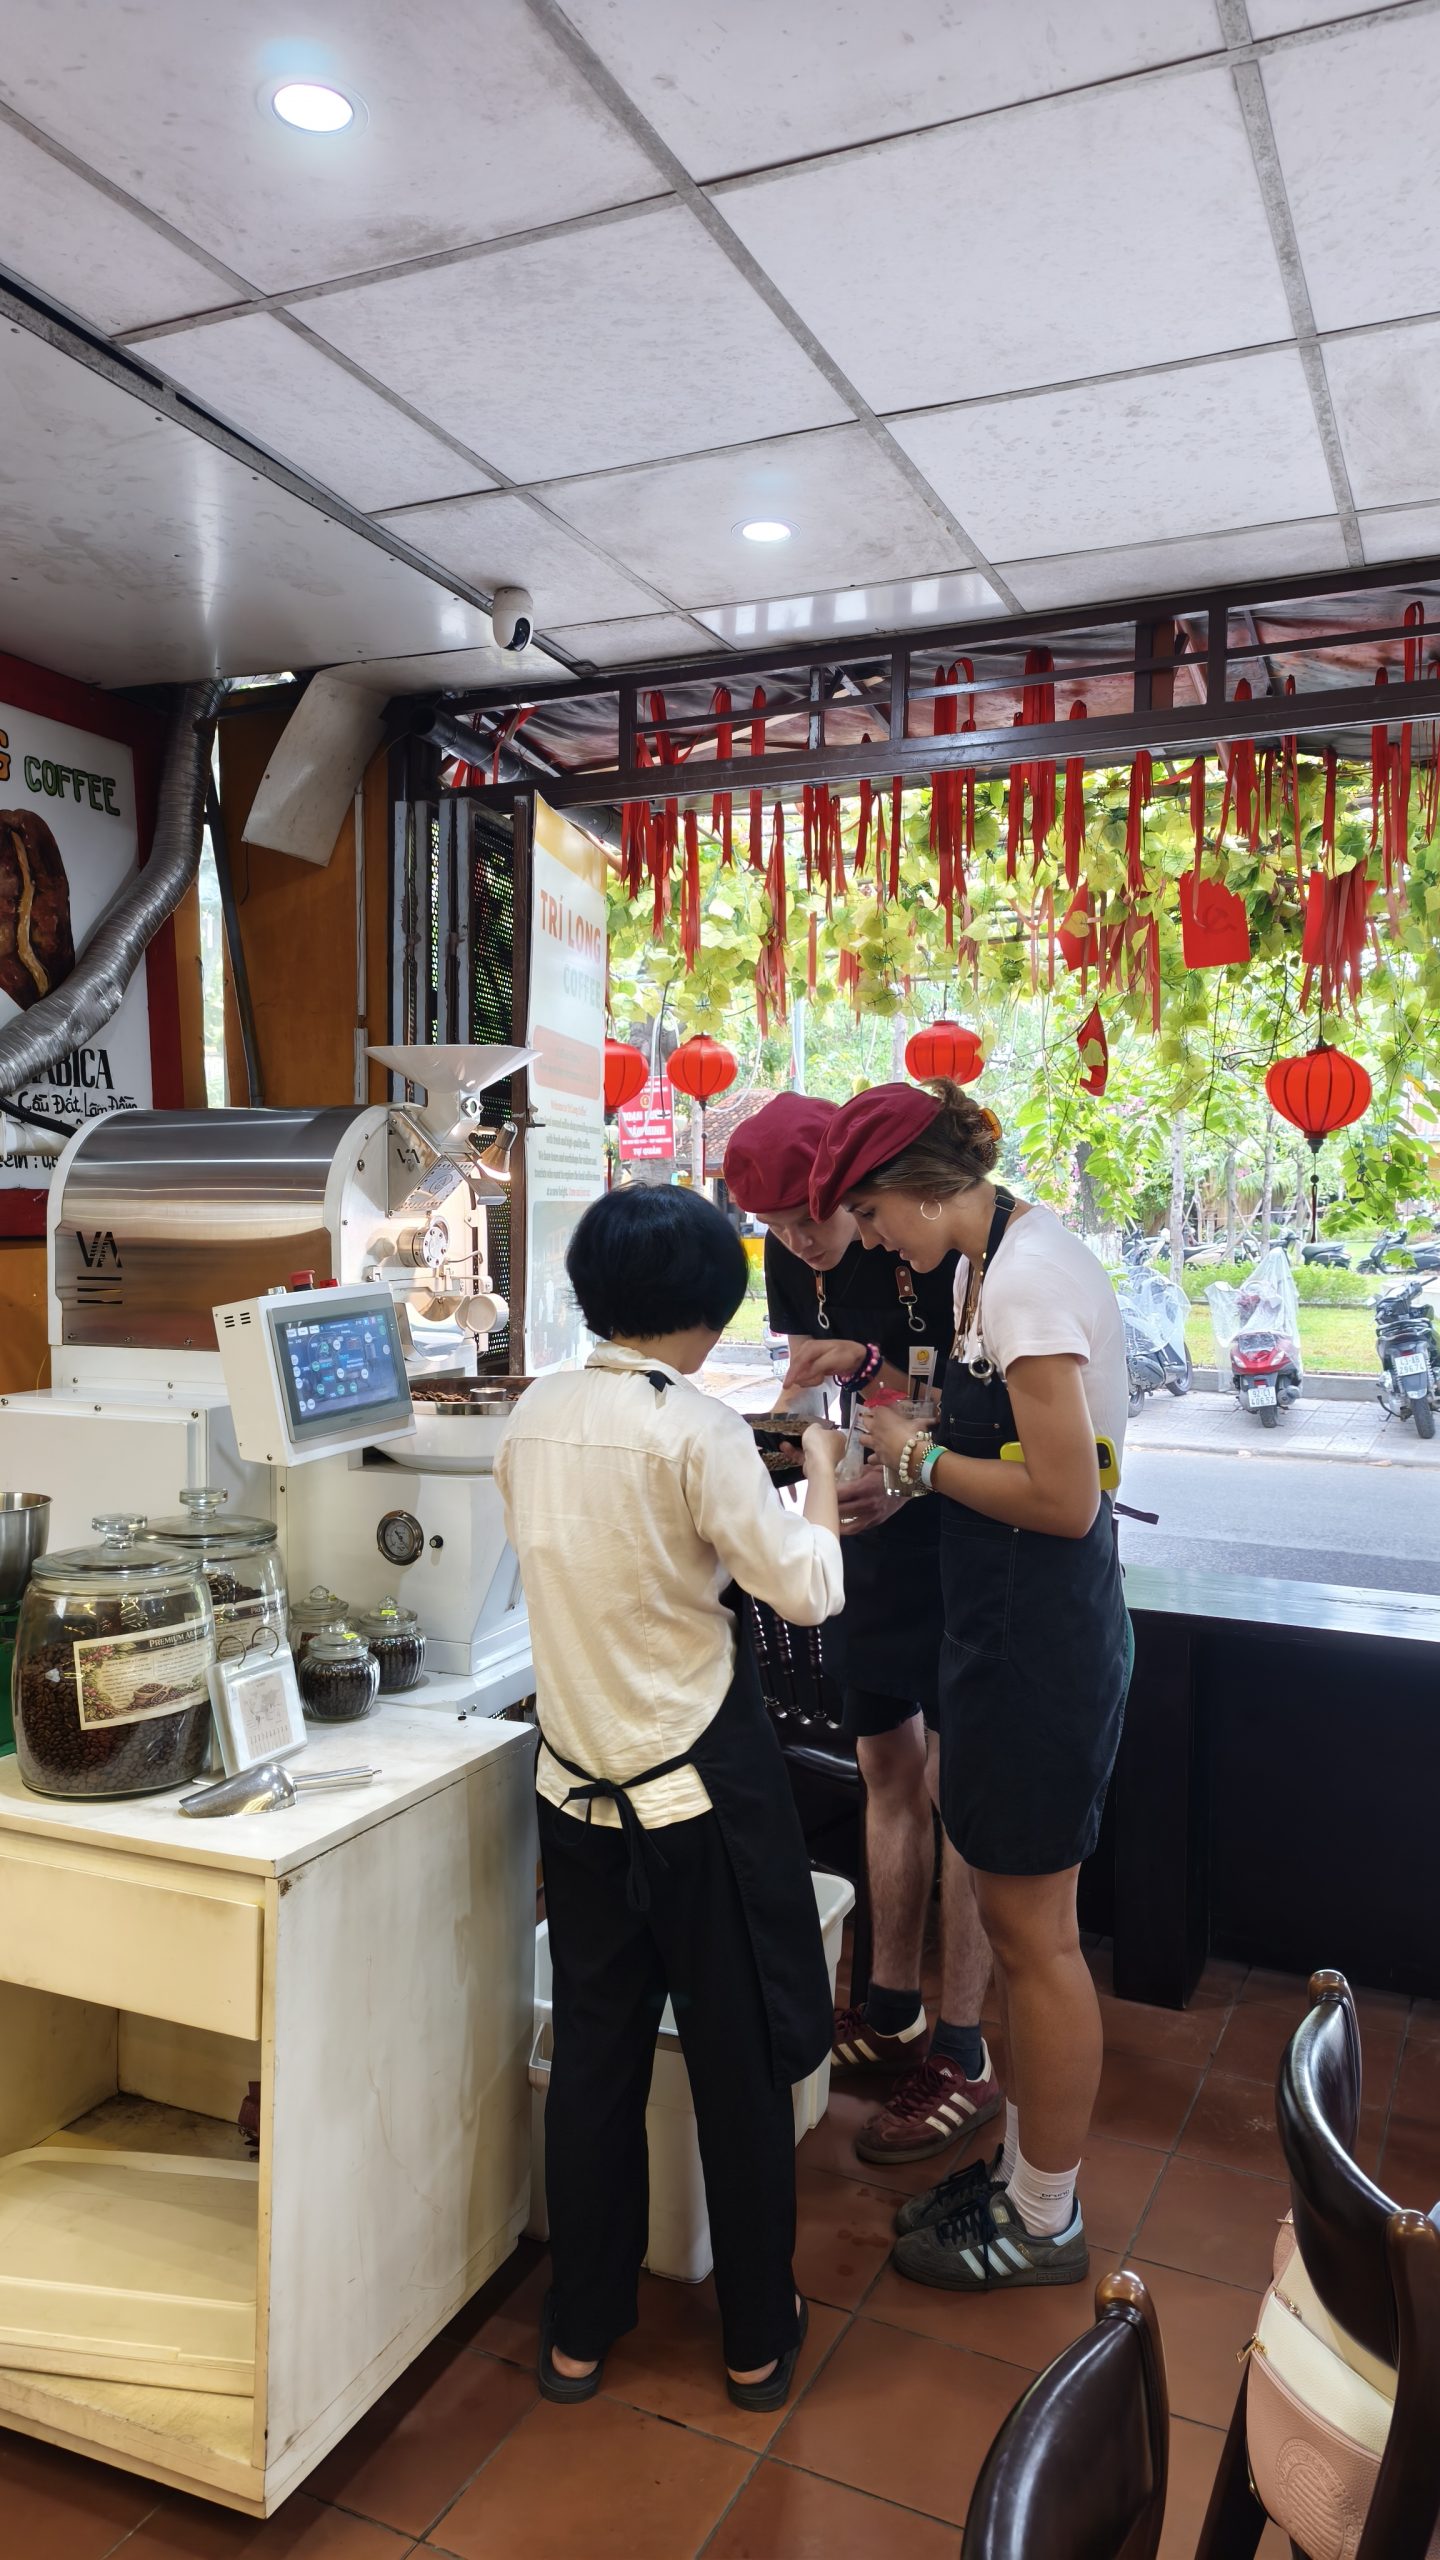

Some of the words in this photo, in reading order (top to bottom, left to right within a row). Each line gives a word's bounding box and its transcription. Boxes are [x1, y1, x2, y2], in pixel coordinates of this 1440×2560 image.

[24, 756, 120, 816] COFFEE
[540, 889, 563, 942] TRÍ
[567, 909, 601, 965] LONG
[563, 964, 601, 1010] COFFEE
[149, 1633, 185, 1648] PREMIUM
